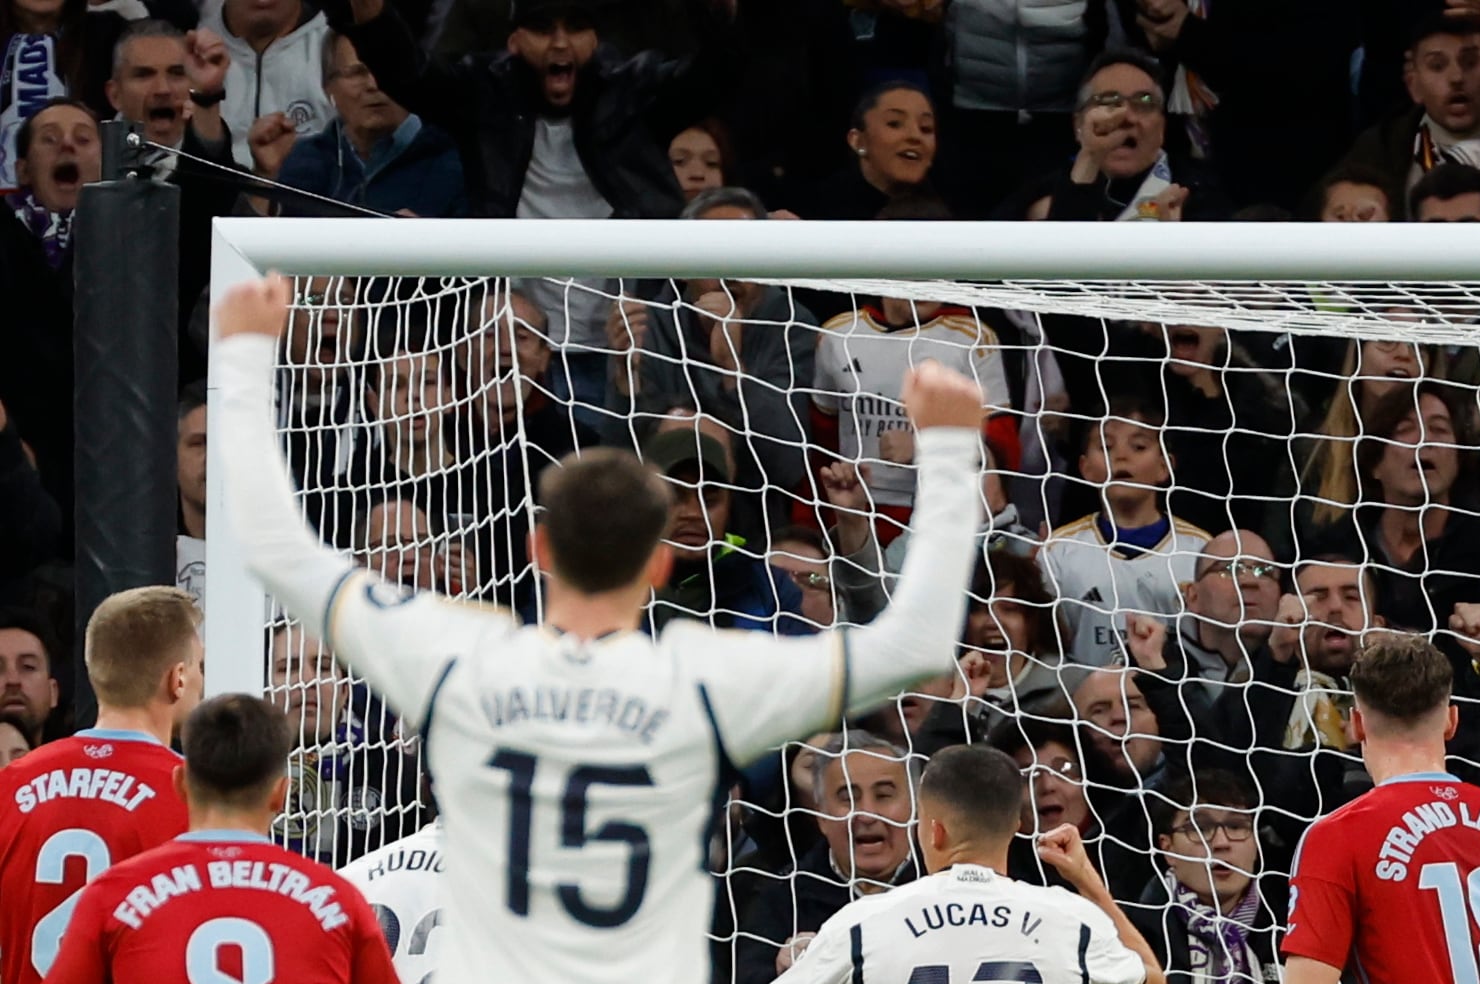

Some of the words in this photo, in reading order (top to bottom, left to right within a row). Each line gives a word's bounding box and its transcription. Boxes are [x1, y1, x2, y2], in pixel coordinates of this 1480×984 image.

[481, 686, 671, 745] VALVERDE
[15, 768, 156, 813] STARFELT
[485, 747, 656, 928] 15
[1376, 802, 1457, 881] STRAND
[113, 864, 202, 930] FRAN
[208, 861, 348, 932] BELTRÁN
[904, 903, 1011, 938] LUCAS
[1020, 911, 1042, 944] V.
